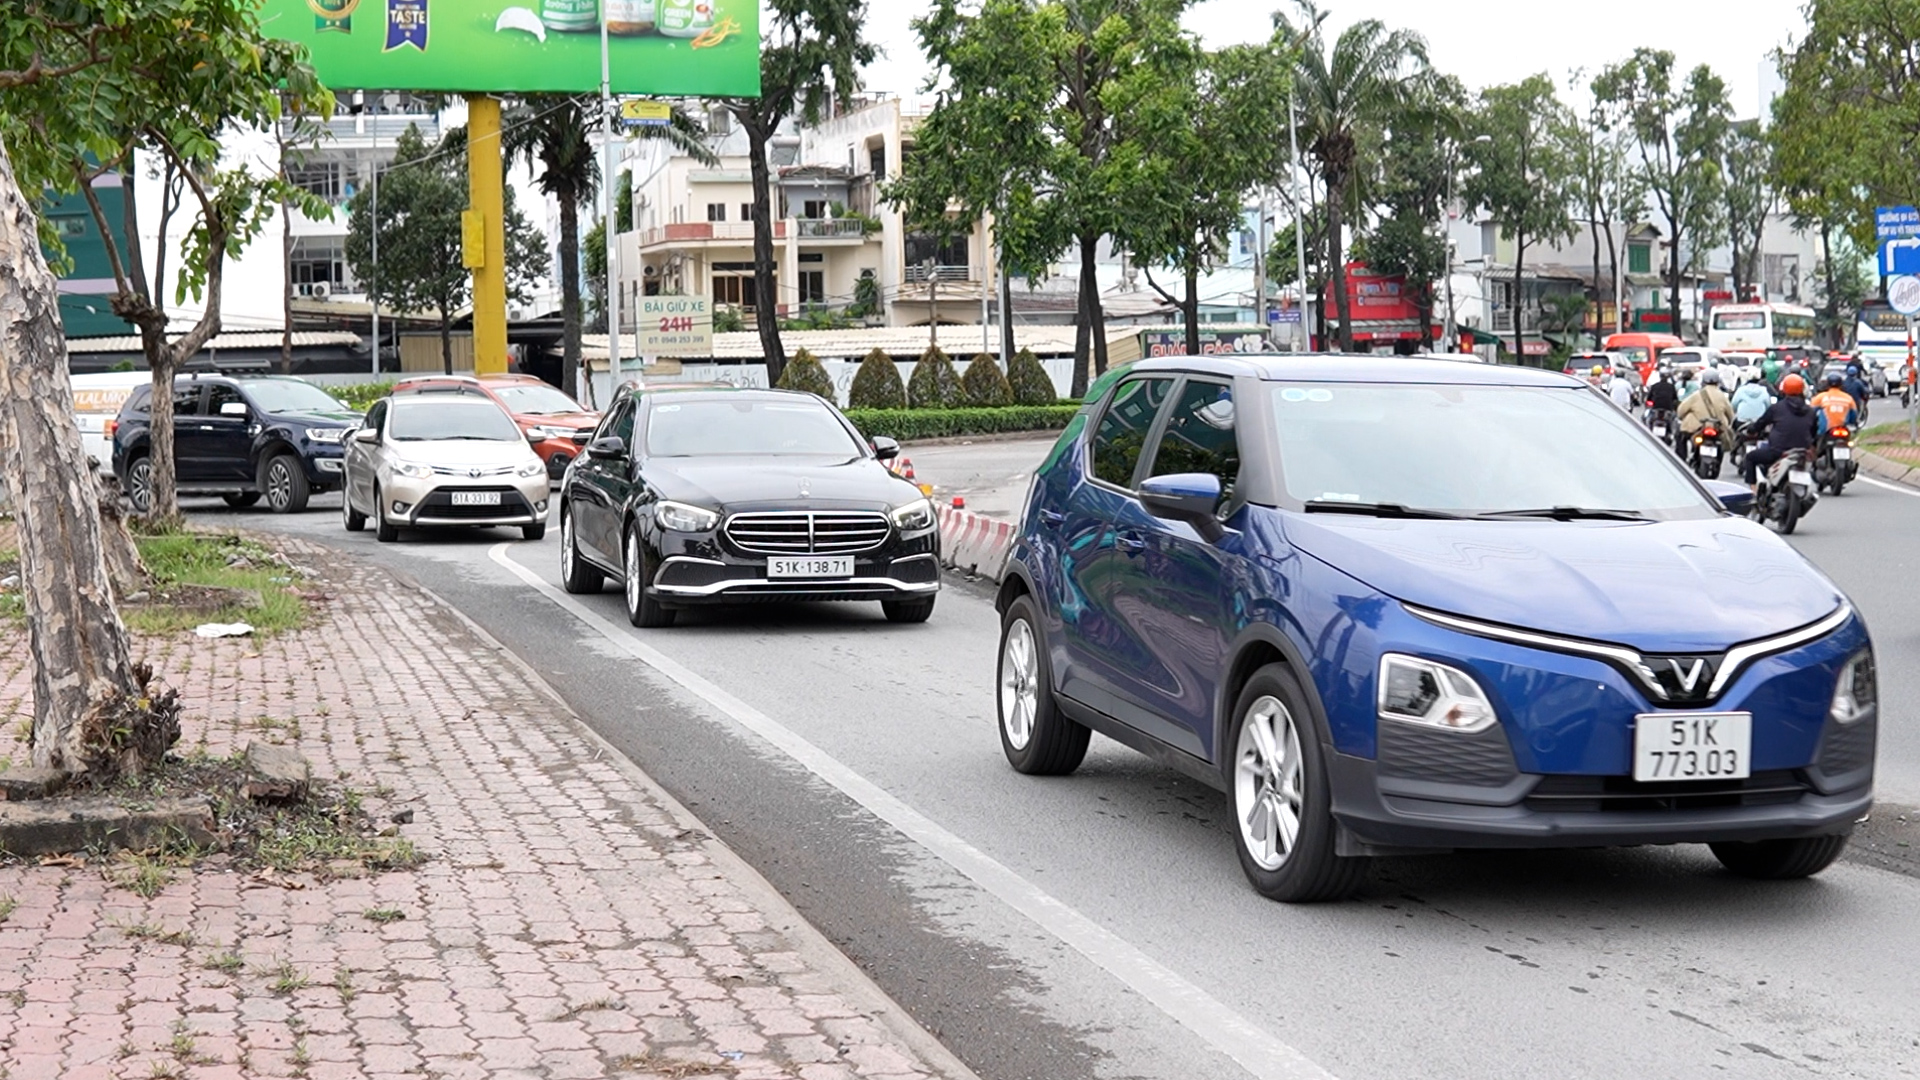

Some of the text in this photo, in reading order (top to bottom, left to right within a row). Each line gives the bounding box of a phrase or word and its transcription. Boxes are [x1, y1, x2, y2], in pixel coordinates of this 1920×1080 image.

[389, 10, 426, 24] TASTE
[1895, 281, 1920, 307] 40
[690, 301, 705, 312] XE
[659, 316, 692, 332] 24H
[775, 561, 847, 574] 51K-138.71
[1670, 720, 1718, 746] 51K
[1650, 749, 1737, 777] 773.03
